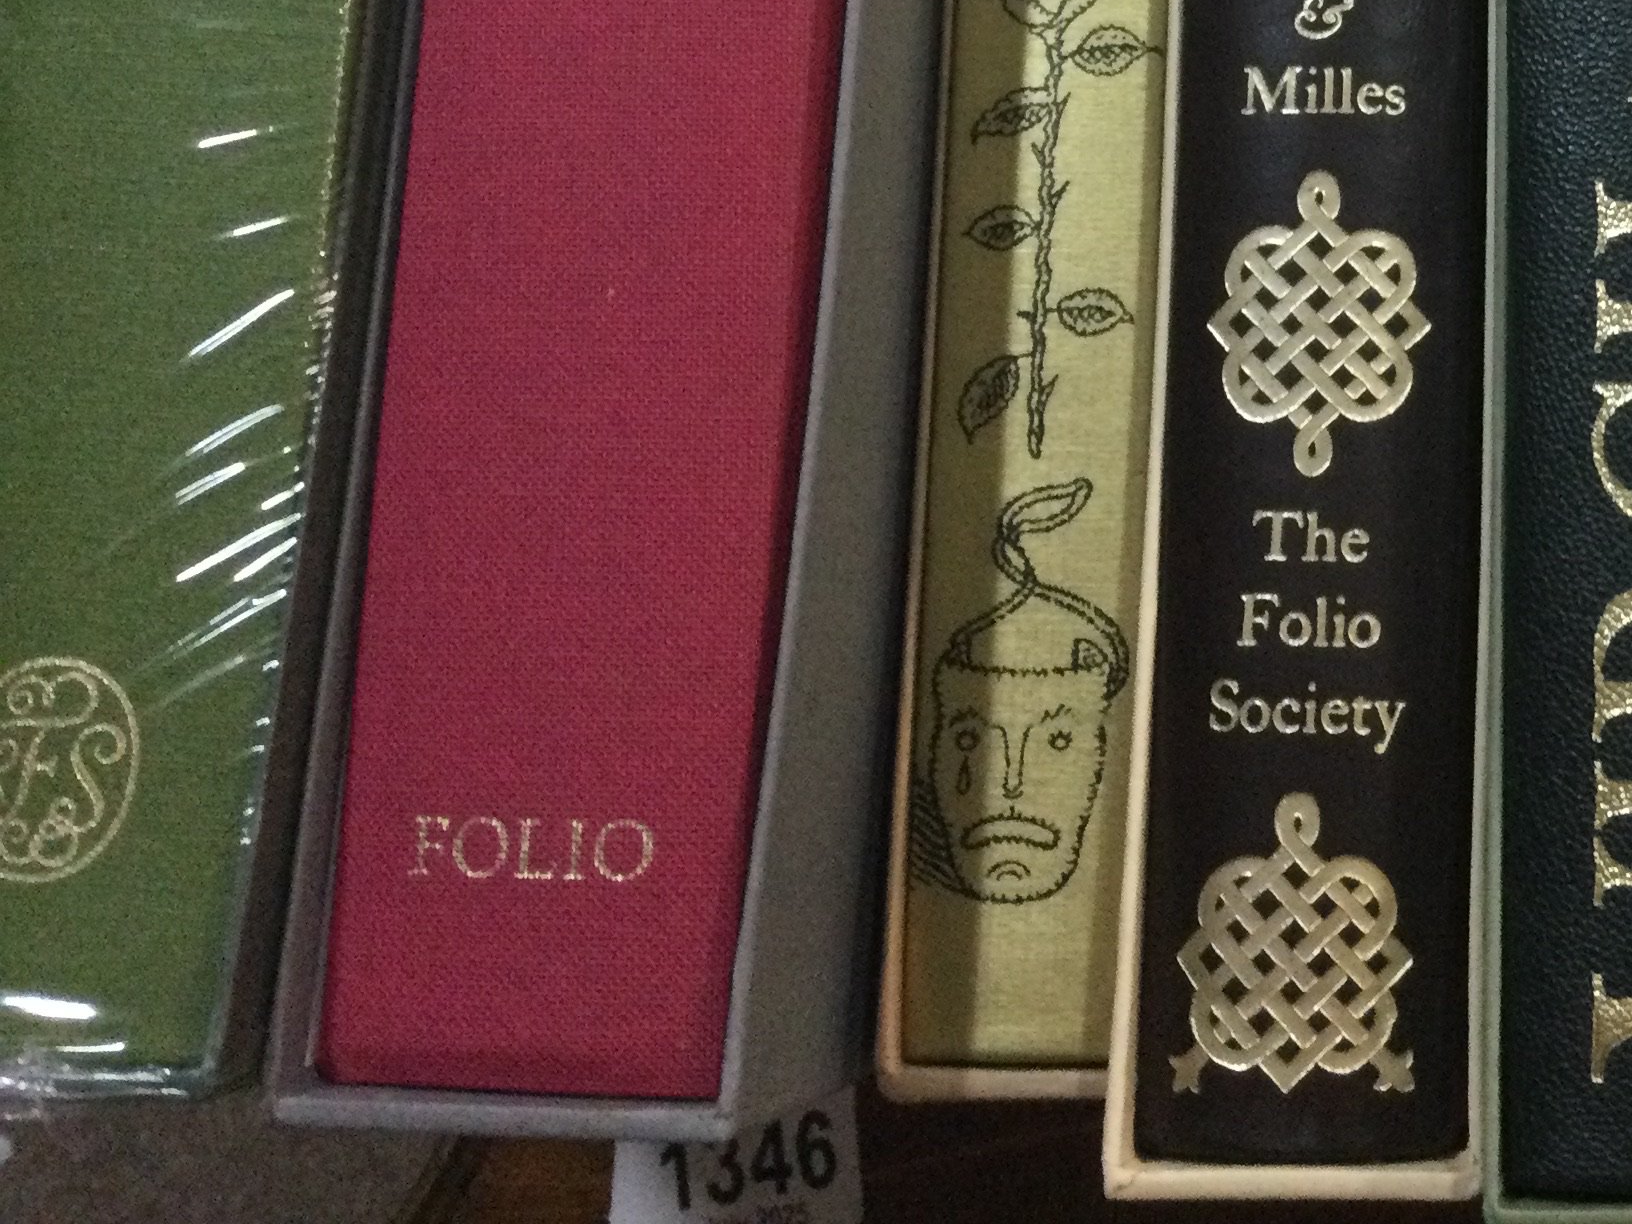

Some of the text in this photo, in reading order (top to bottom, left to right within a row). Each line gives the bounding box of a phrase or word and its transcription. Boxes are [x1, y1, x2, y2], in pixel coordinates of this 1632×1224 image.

[1241, 64, 1406, 115] Milles
[1252, 509, 1370, 563] The
[1236, 592, 1382, 649] Folio
[1209, 677, 1407, 755] Society
[407, 815, 656, 882] FOLIO
[660, 1109, 837, 1212] 1346
